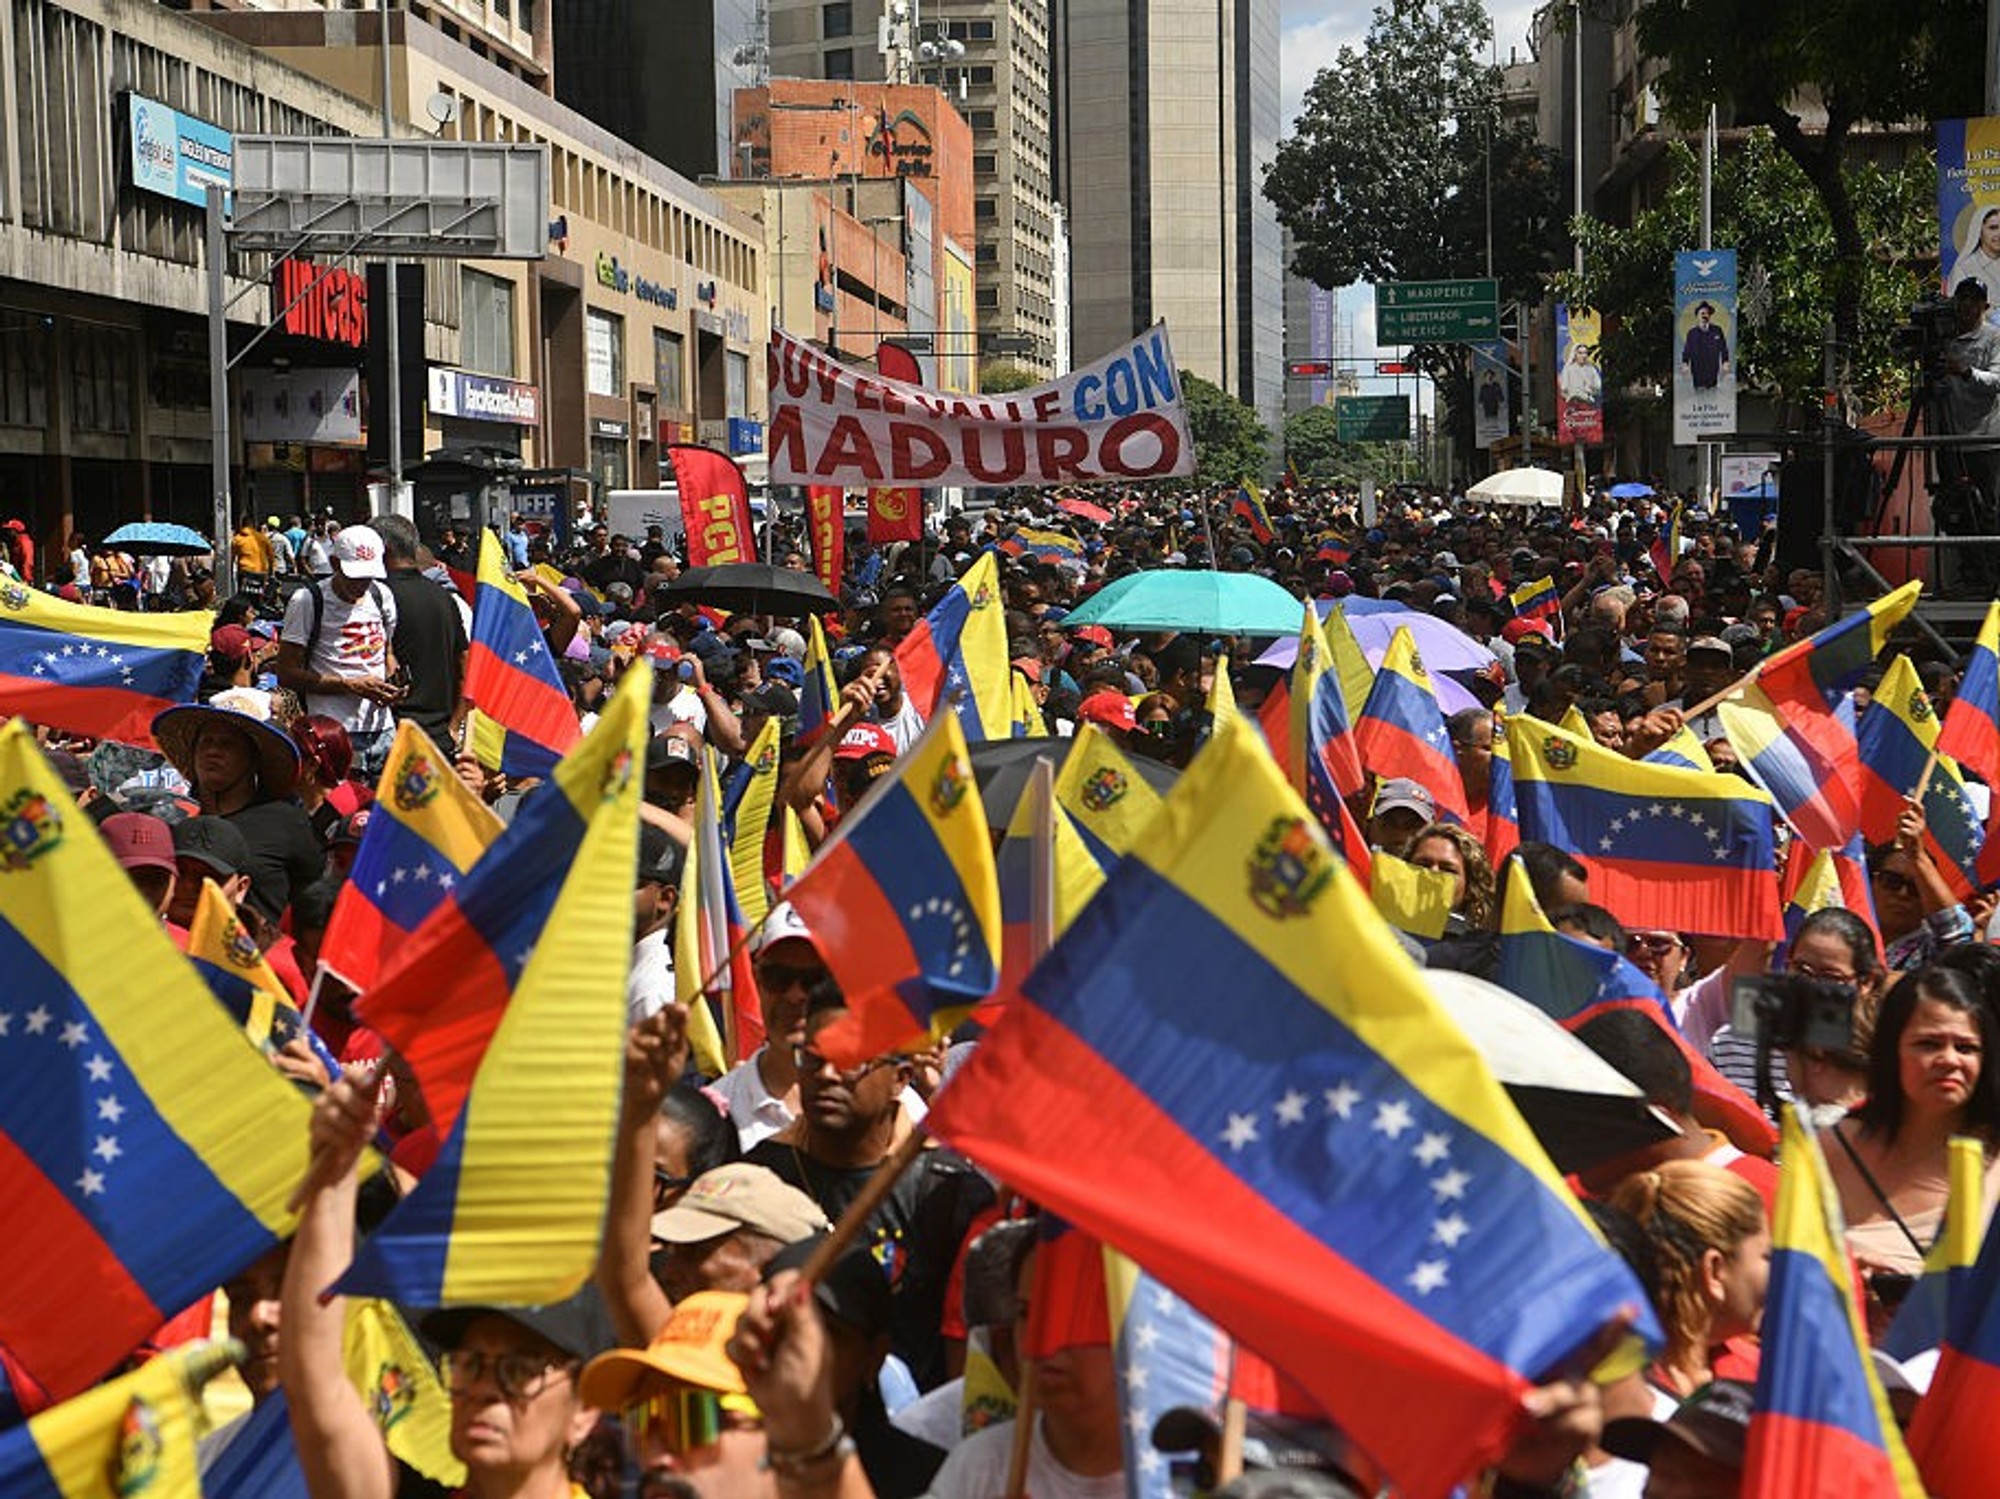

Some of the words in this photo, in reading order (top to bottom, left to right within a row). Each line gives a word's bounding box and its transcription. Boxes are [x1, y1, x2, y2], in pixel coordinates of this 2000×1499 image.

[284, 258, 367, 347] unicas
[1400, 310, 1461, 322] LIBERTADOR
[1073, 333, 1176, 422] CON
[769, 404, 1180, 483] MADURO
